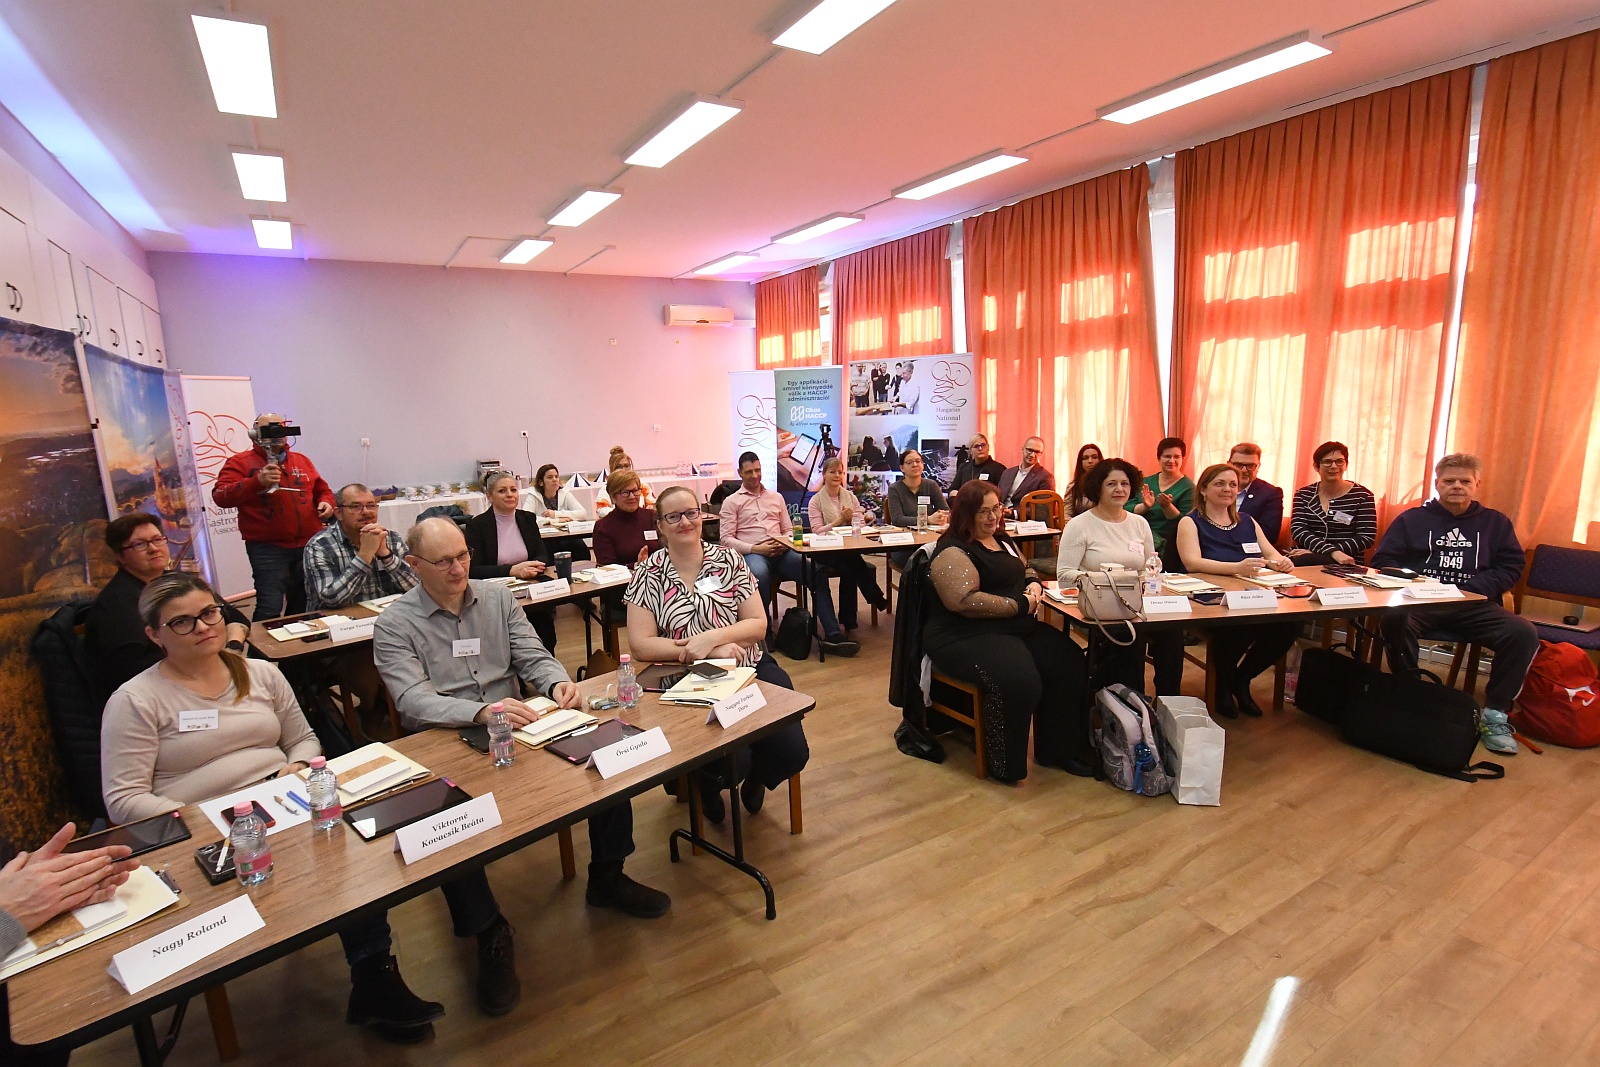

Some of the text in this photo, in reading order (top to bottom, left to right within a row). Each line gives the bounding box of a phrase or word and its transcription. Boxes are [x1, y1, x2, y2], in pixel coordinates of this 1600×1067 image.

[1439, 556, 1463, 569] 1949
[629, 740, 648, 751] Gyula
[432, 811, 469, 832] Viktorné
[421, 817, 484, 848] Kovacsik Beáta
[152, 915, 228, 958] Nagy Roland
